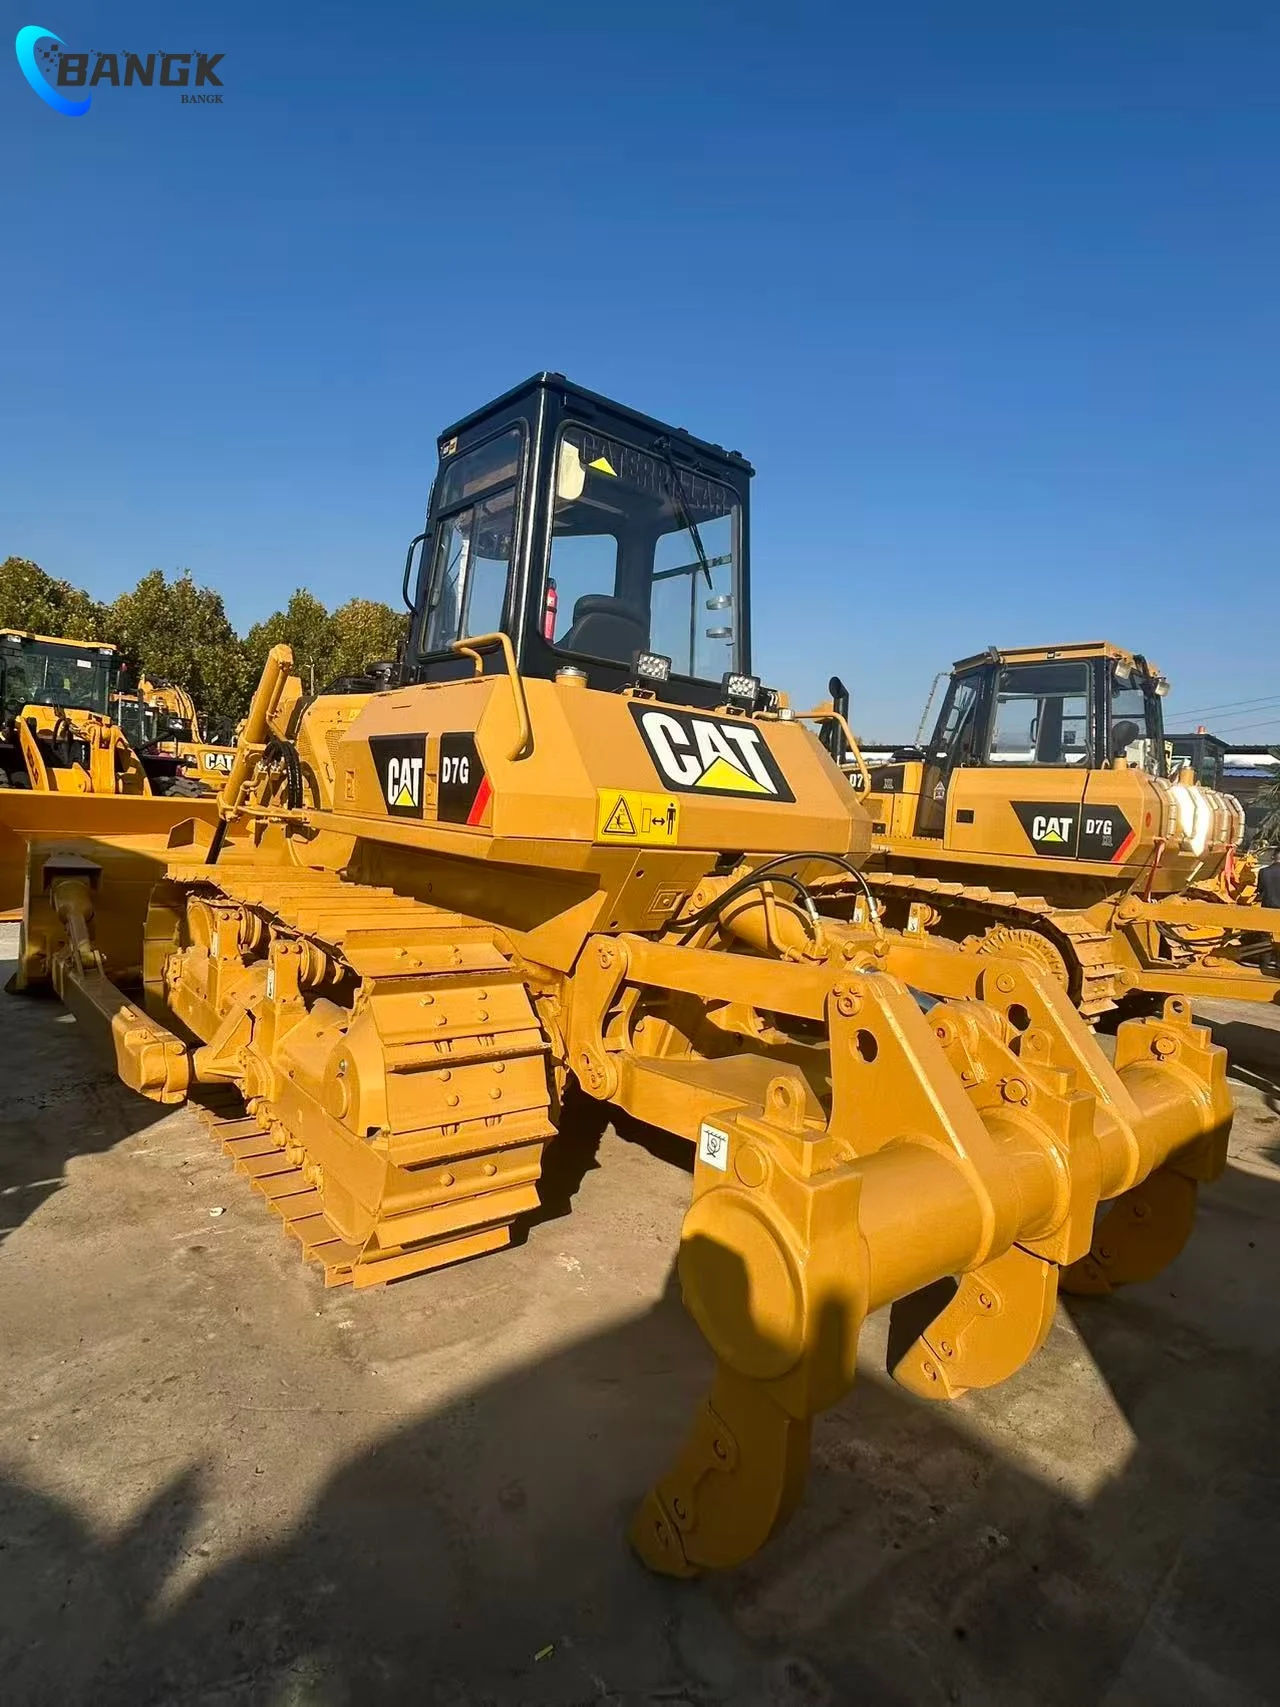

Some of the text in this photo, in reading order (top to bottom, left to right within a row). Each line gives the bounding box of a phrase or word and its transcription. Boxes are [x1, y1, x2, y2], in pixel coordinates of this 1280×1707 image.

[205, 752, 234, 771] CAT
[642, 712, 778, 794] CAT
[388, 756, 469, 807] CAT D7G
[1032, 815, 1113, 843] CAT D7G
